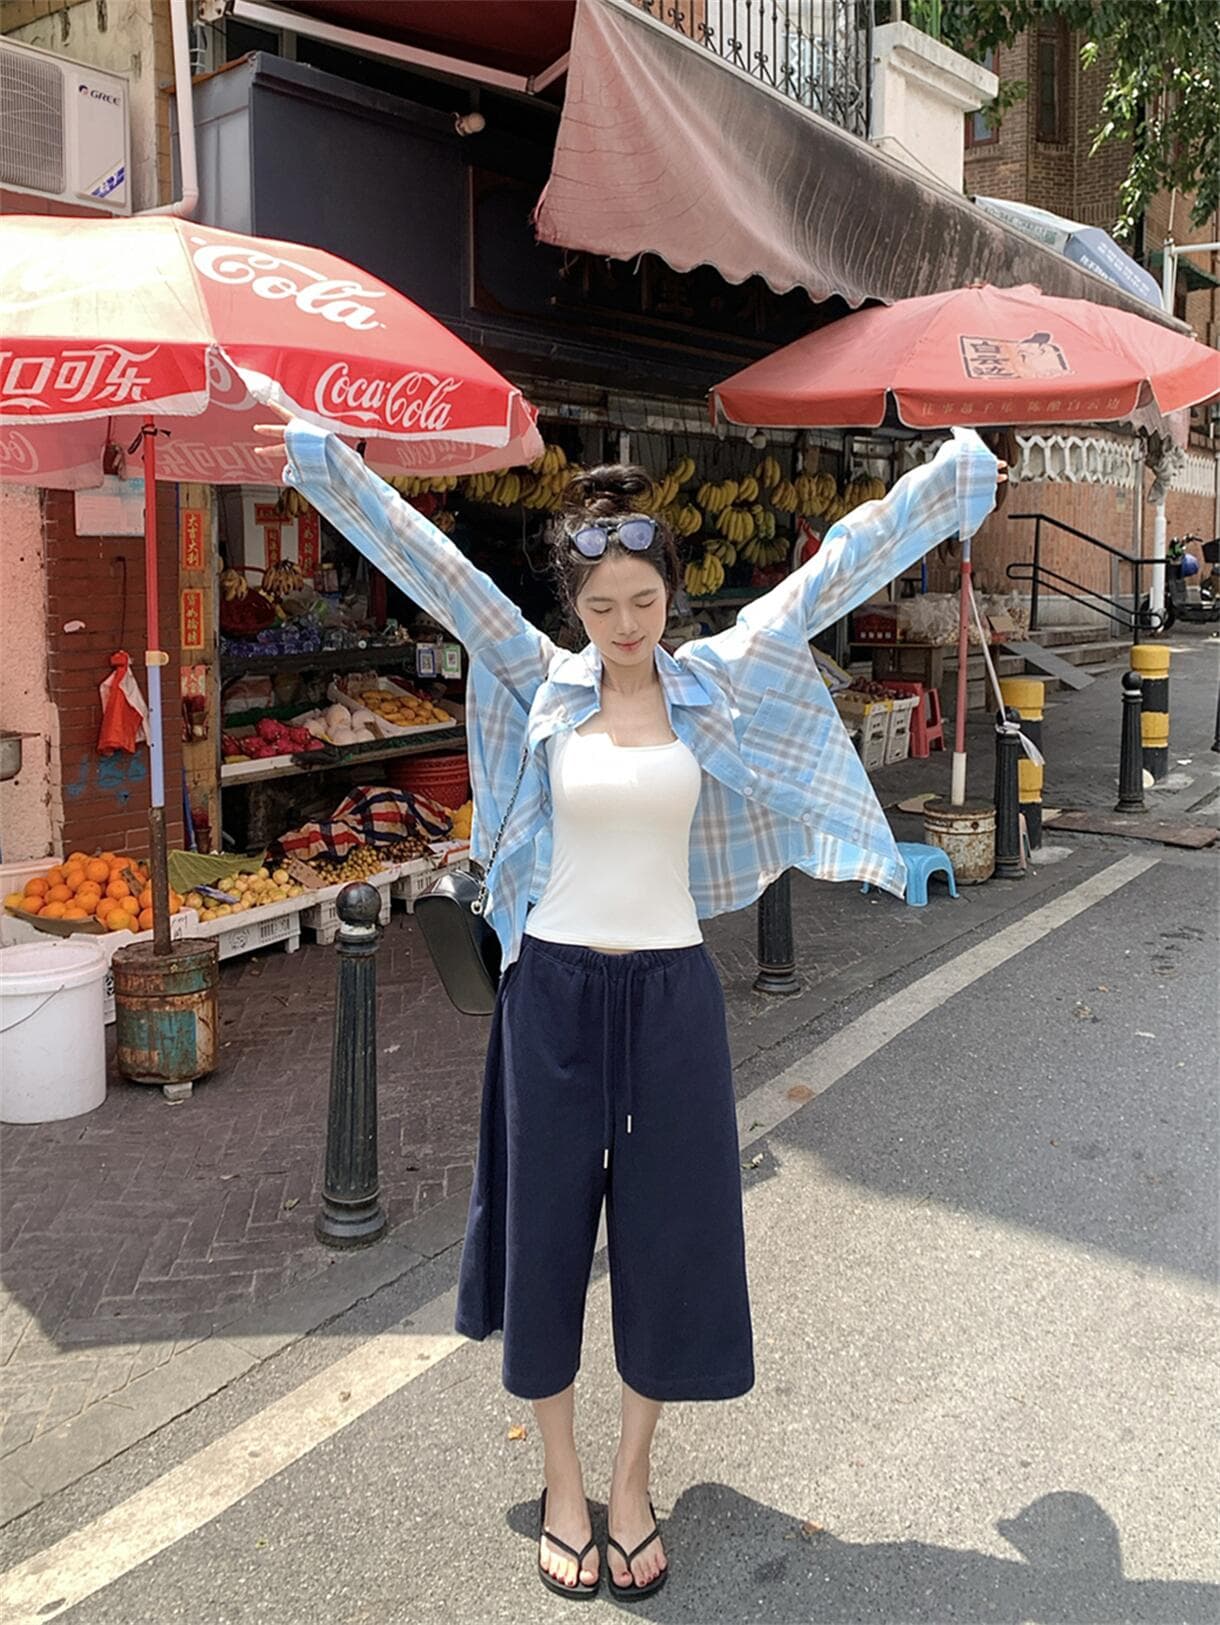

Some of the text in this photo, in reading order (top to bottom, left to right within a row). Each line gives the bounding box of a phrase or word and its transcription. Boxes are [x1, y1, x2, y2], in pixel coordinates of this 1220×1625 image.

[90, 89, 121, 106] GREE
[191, 240, 386, 331] Cola
[0, 345, 160, 402] 口可乐
[314, 361, 463, 430] Coca-Cola
